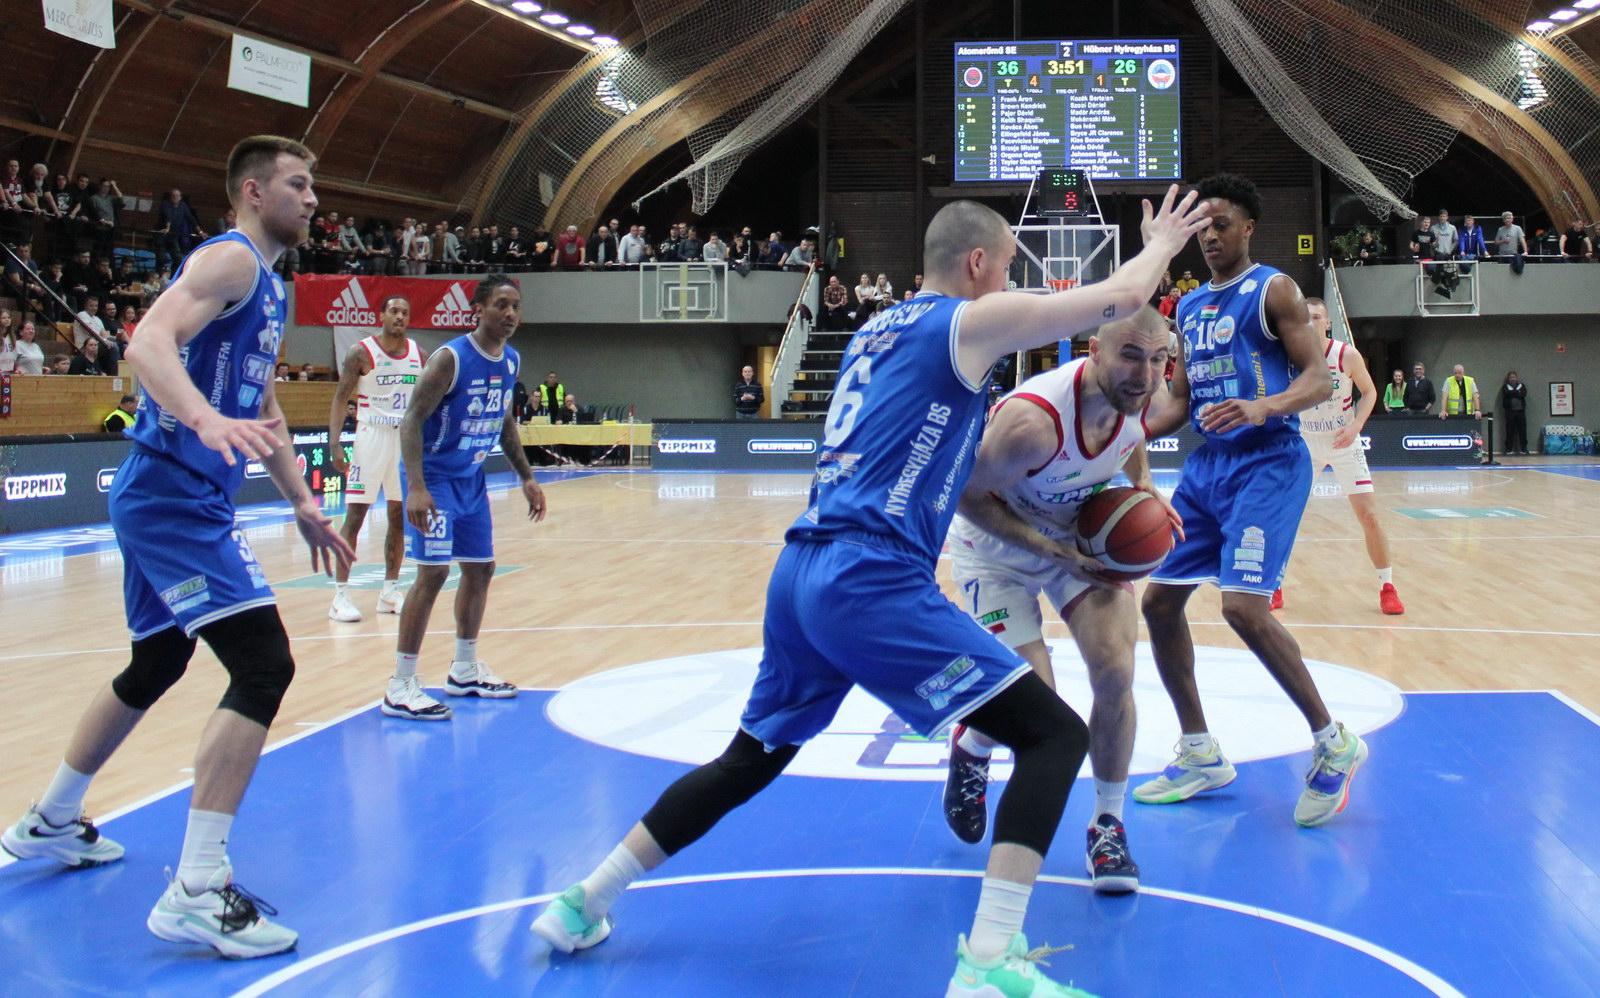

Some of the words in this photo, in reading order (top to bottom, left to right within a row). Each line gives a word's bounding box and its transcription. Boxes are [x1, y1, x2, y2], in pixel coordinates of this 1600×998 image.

[1005, 46, 1017, 54] SE
[1063, 46, 1070, 57] 2
[1164, 44, 1176, 52] BS
[997, 61, 1018, 75] 36
[1048, 60, 1084, 74] 3:51
[1114, 60, 1136, 74] 26
[1004, 79, 1012, 88] T
[1030, 76, 1037, 86] 4
[1096, 74, 1104, 86] 1
[1122, 78, 1128, 86] T
[1064, 192, 1077, 209] 8
[1301, 238, 1311, 248] B
[326, 307, 376, 325] adidas
[392, 392, 408, 410] 21
[485, 388, 502, 413] 23
[823, 355, 873, 449] 6
[884, 425, 942, 517] NYÍREGYHÁZA
[926, 402, 951, 427] BS
[349, 466, 360, 482] 21
[1241, 574, 1263, 584] JAKO
[964, 578, 979, 615] 7
